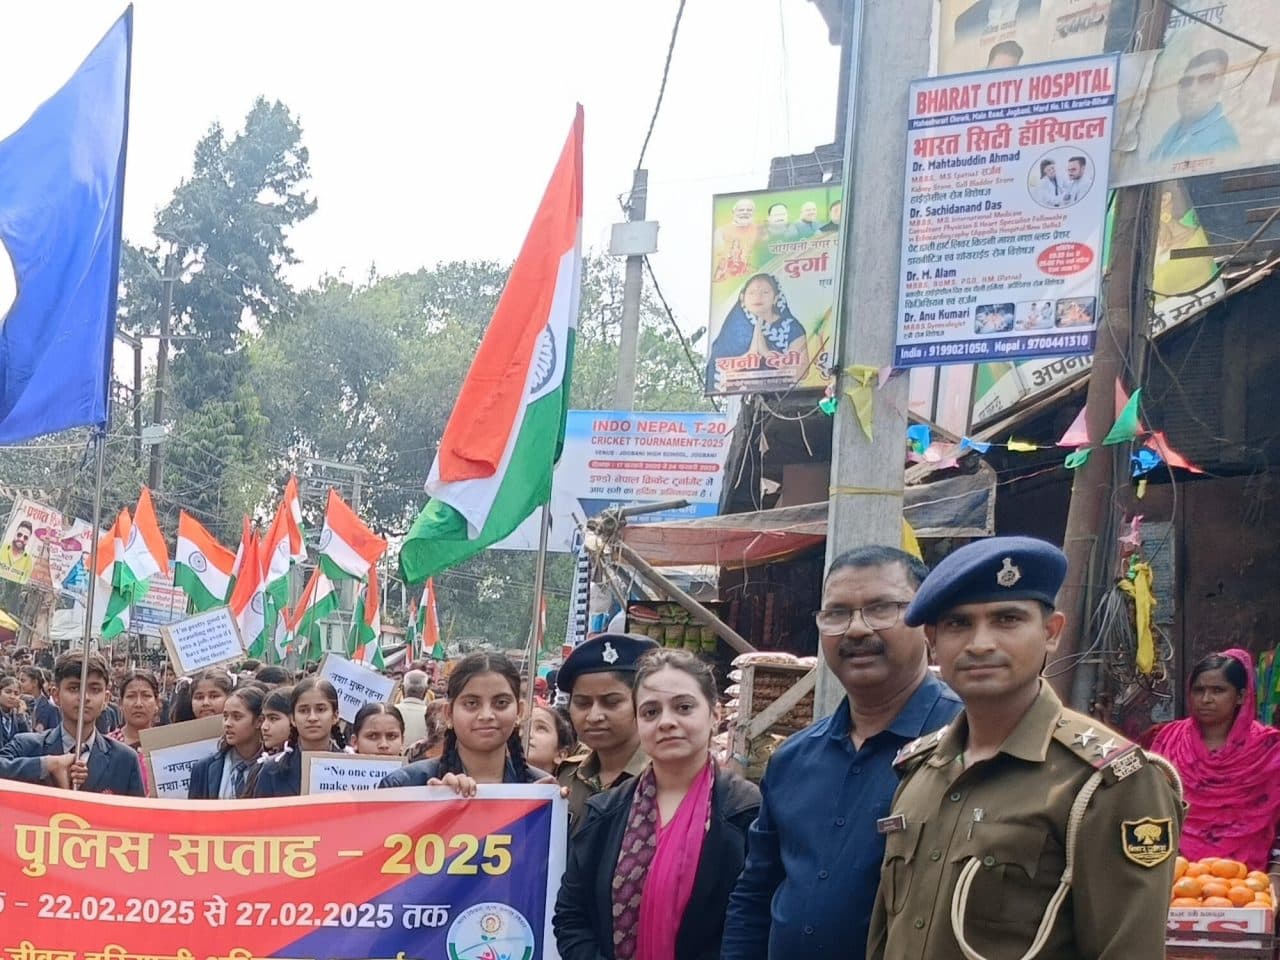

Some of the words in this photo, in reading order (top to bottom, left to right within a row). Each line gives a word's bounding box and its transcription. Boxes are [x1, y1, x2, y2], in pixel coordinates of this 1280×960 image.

[916, 84, 981, 115] BHARAT
[987, 79, 1023, 105] CITY
[1029, 67, 1111, 100] HOSPITAL
[913, 133, 961, 158] भारत
[967, 122, 1012, 153] सिटी
[1019, 116, 1107, 147] हॉस्पिटल
[912, 161, 925, 172] Dr.
[928, 155, 987, 171] Mahtabuddin
[989, 151, 1020, 164] Ahmad
[910, 207, 922, 218] Dr.
[925, 201, 982, 216] Sachidanand
[984, 200, 1002, 211] Das
[784, 252, 829, 278] दुर्गा
[906, 270, 918, 281] Dr.
[935, 267, 957, 279] Alam
[904, 312, 916, 323] Dr.
[919, 311, 936, 321] Anu
[938, 307, 970, 319] Kumari
[900, 347, 921, 359] India
[928, 342, 989, 357] 9199021050,
[995, 340, 1020, 354] Nepal
[1028, 335, 1088, 349] 9700441310
[593, 420, 632, 433] INDO
[636, 421, 687, 433] NEPAL
[694, 422, 726, 434] T-20
[591, 436, 631, 446] CRICKET
[634, 437, 724, 448] TOURNAMENT-2025
[188, 621, 205, 631] pretty
[349, 679, 365, 692] मुक्त
[364, 687, 384, 701] रहना
[348, 769, 367, 777] one
[369, 770, 387, 778] can
[320, 780, 349, 791] make
[14, 813, 153, 878] पुलिस
[168, 834, 321, 877] सप्ताह
[381, 833, 513, 876] 2025
[38, 894, 195, 925] 22.02.2025
[203, 894, 229, 928] से
[235, 902, 395, 929] 27.02.2025
[402, 903, 452, 930] तक
